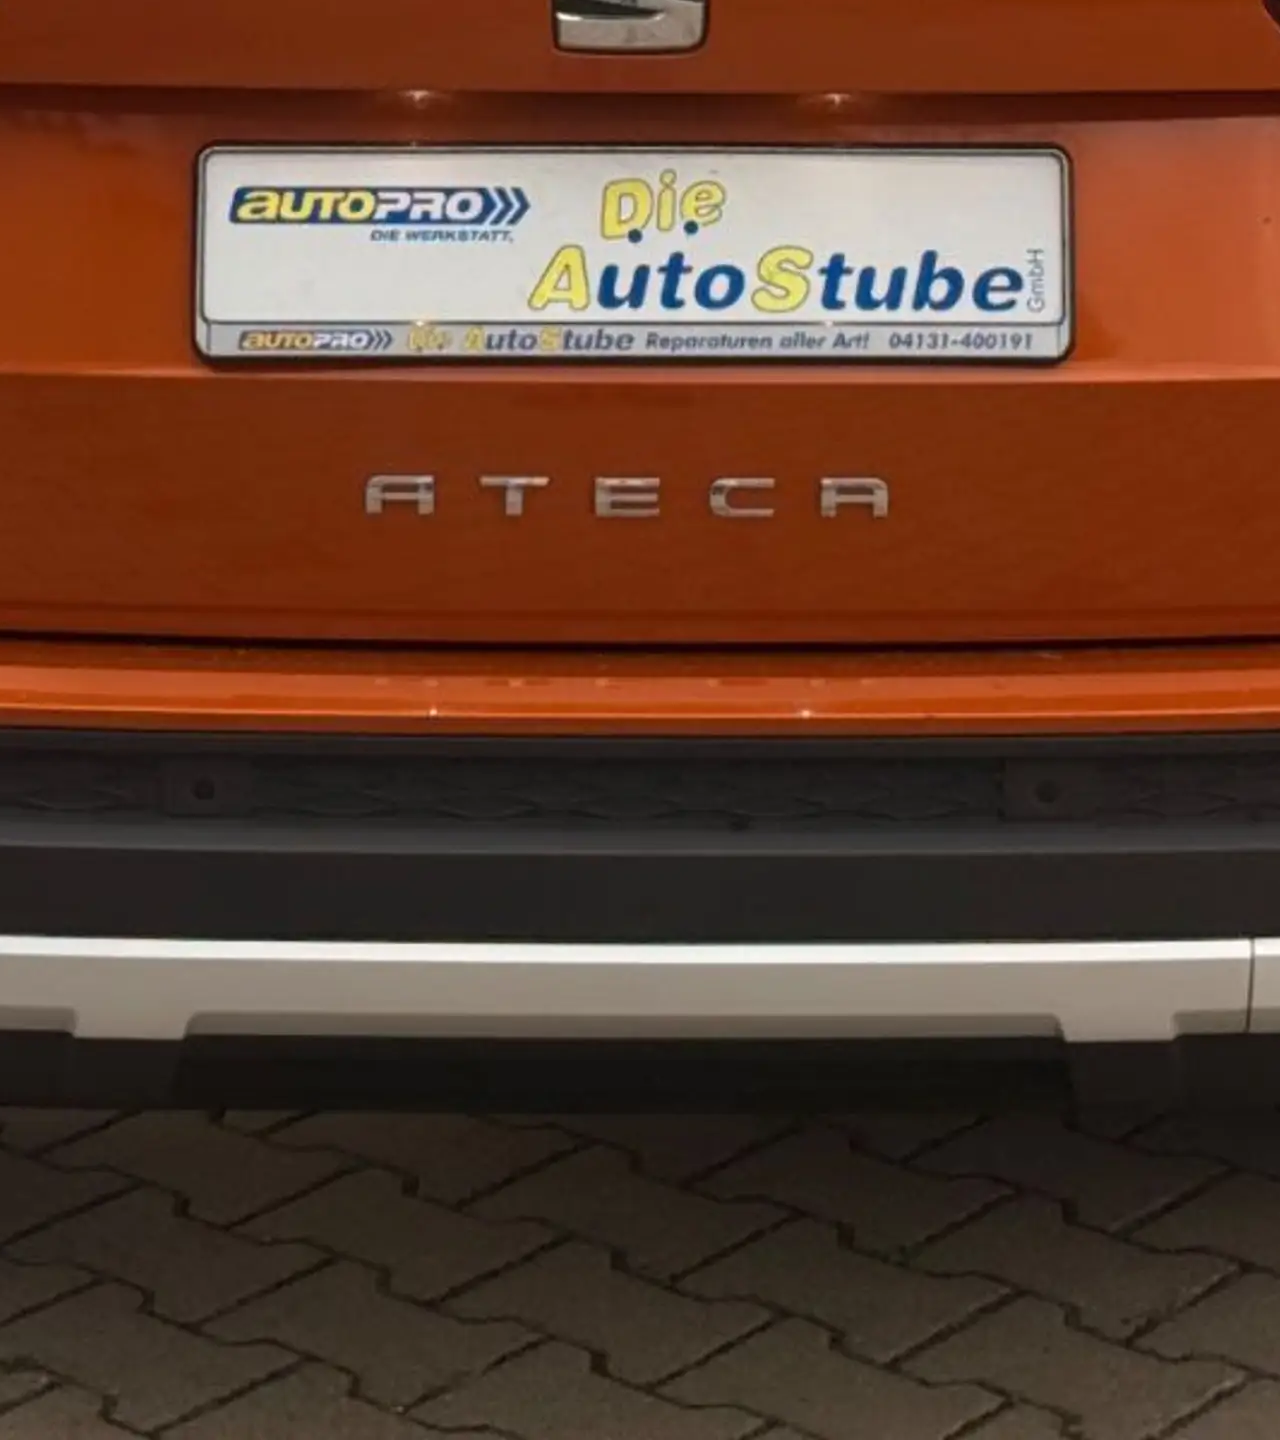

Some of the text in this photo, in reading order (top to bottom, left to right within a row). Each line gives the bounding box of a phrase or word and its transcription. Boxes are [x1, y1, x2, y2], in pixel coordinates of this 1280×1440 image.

[600, 168, 726, 240] Die
[370, 229, 400, 242] DIE
[528, 245, 1023, 313] AutoStube
[1025, 248, 1046, 312] GmbH
[464, 324, 634, 352] AutoStube
[645, 332, 774, 352] Reparaturen
[779, 331, 826, 350] aller
[888, 331, 1035, 351] 04131-400191
[365, 474, 889, 518] ATECA
